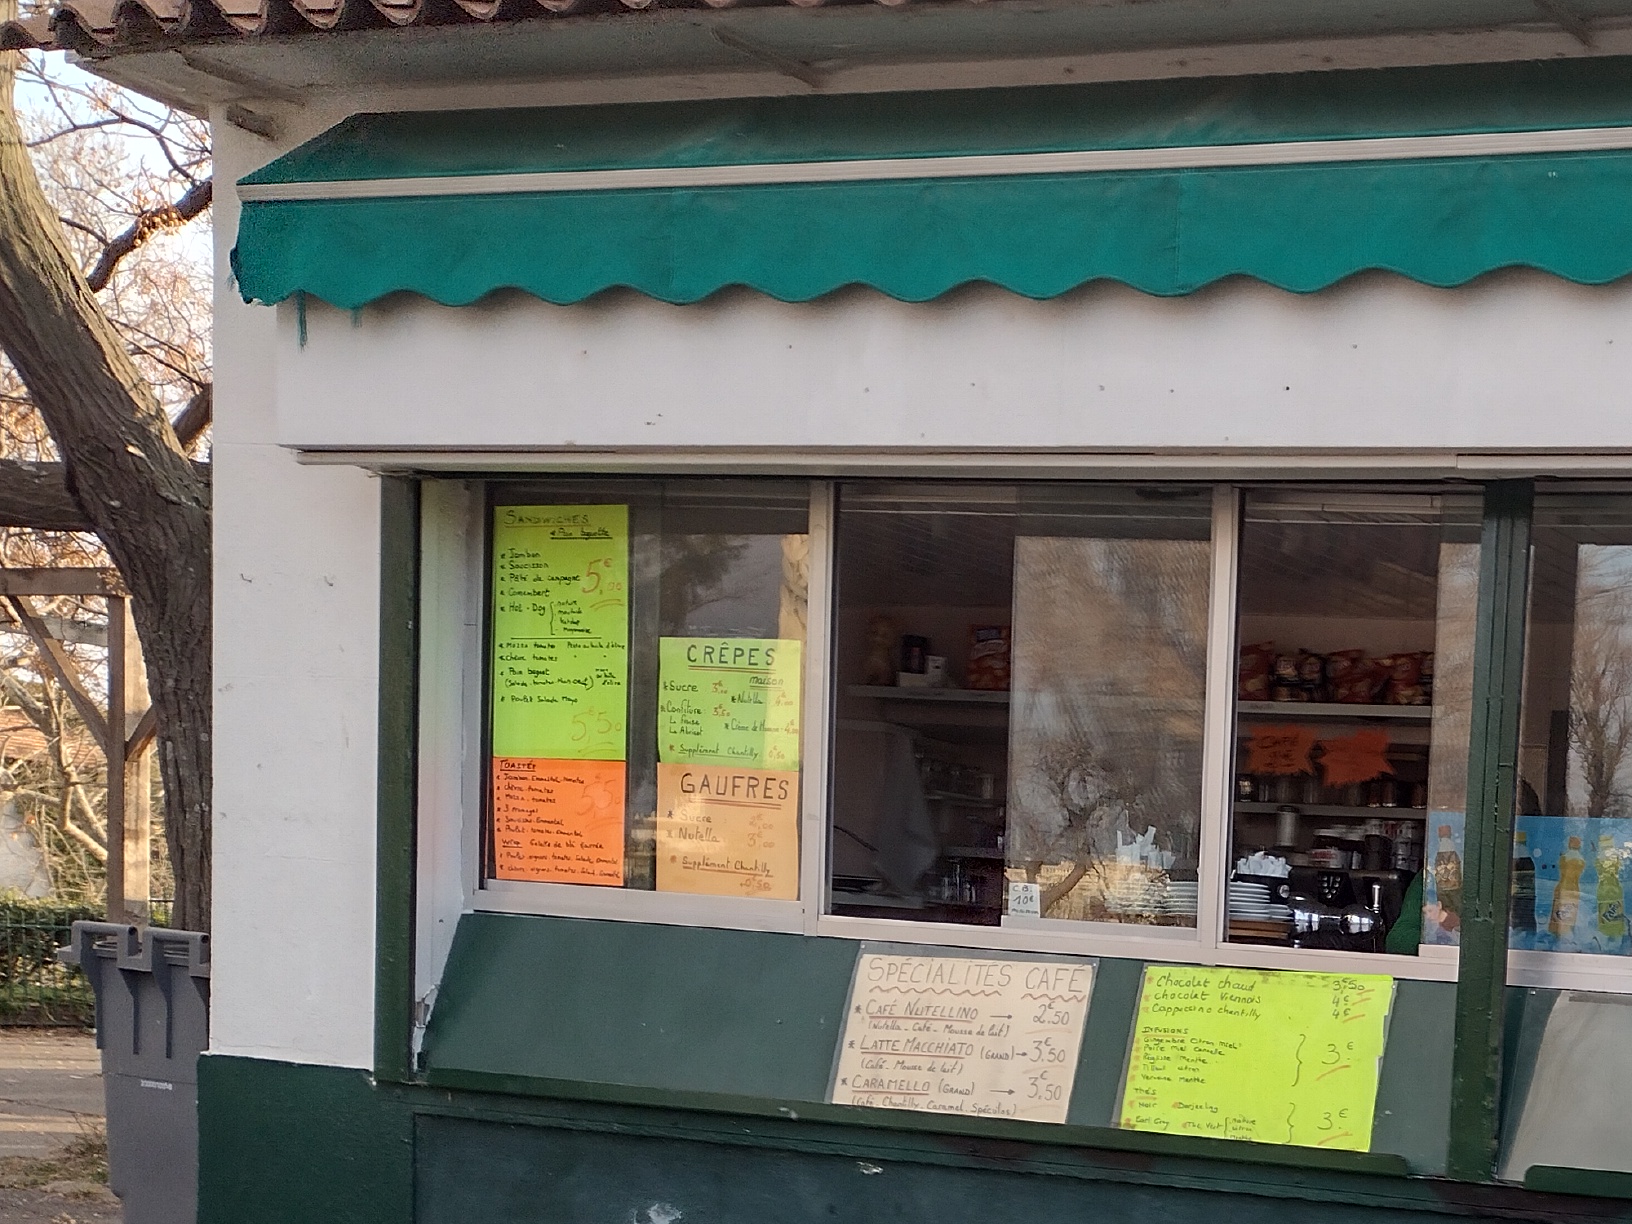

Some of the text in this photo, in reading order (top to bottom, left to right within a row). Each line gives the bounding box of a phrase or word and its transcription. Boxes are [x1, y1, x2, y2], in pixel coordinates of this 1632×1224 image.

[687, 642, 775, 666] CRÊPES
[669, 680, 699, 692] Sucre
[749, 676, 784, 686] maison
[681, 772, 789, 800] GAUFRES
[680, 809, 712, 823] Sucre
[678, 827, 720, 843] Nutella
[868, 957, 1086, 993] SPÉCIALITÉS CAFÉ
